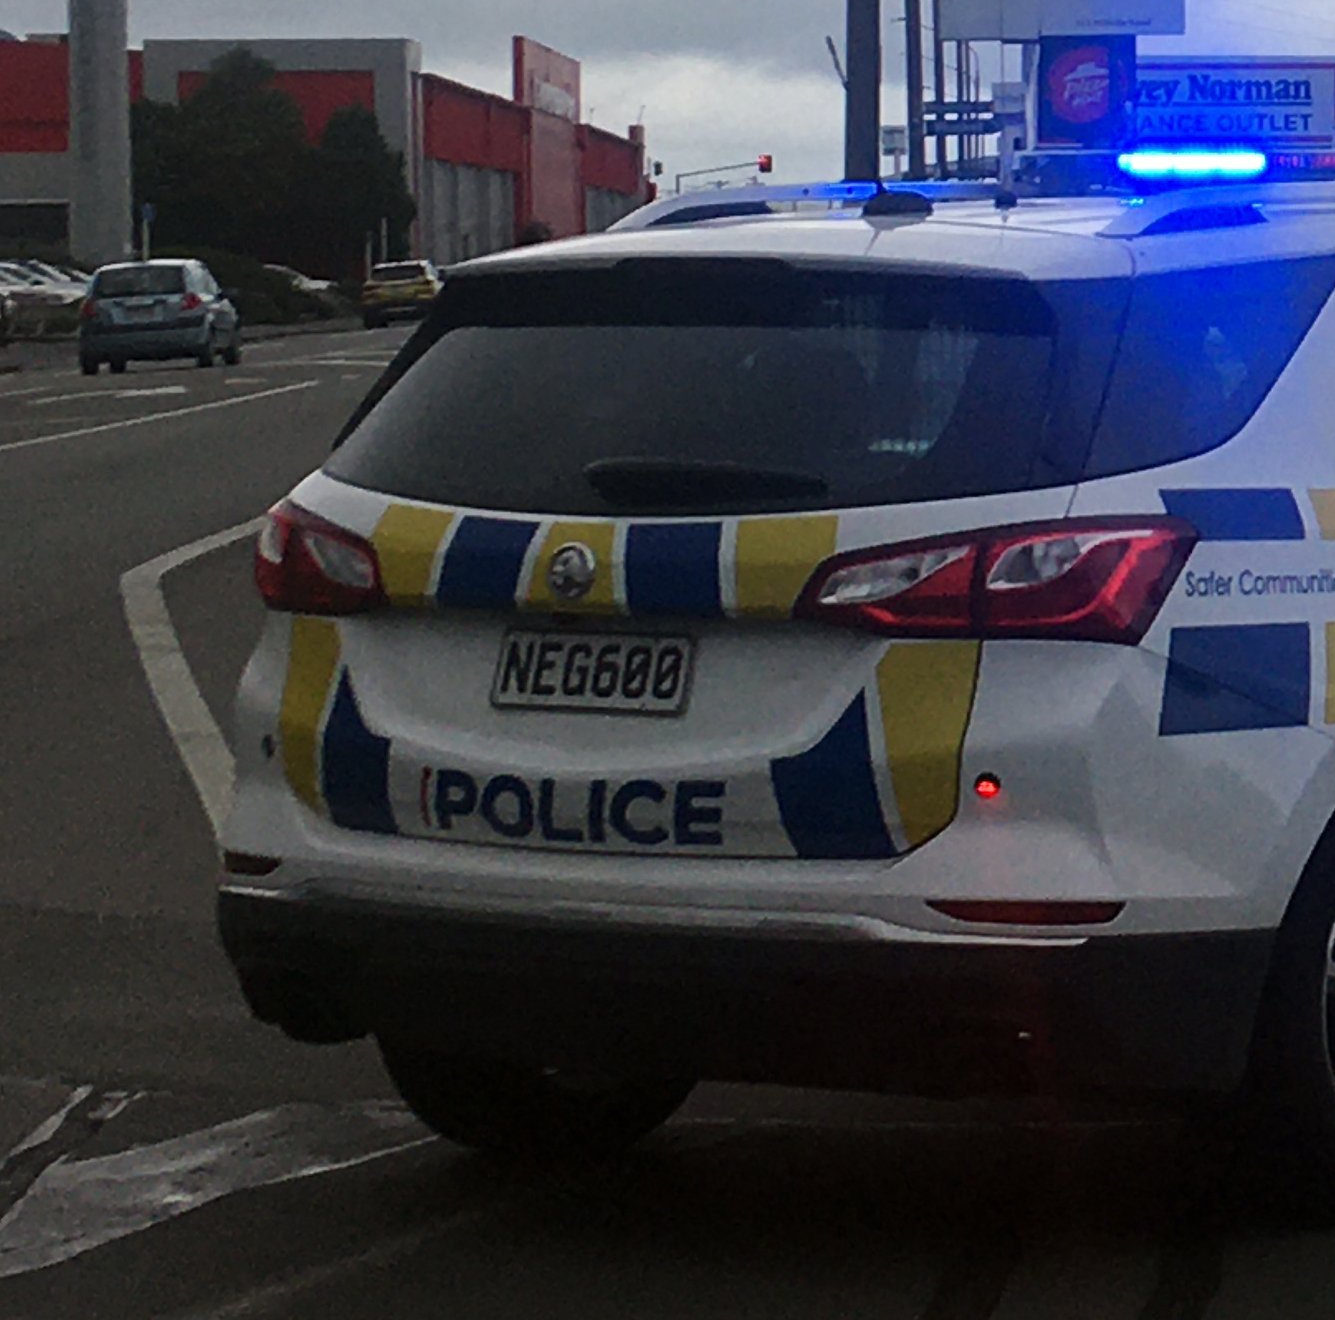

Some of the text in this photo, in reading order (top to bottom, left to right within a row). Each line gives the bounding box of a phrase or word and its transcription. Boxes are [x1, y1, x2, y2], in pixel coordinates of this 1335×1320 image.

[1187, 73, 1313, 101] Norman
[1139, 113, 1313, 132] ANCE OUTLET
[1184, 570, 1233, 597] Safer
[500, 639, 685, 700] NEG600
[433, 768, 730, 845] POLICE
